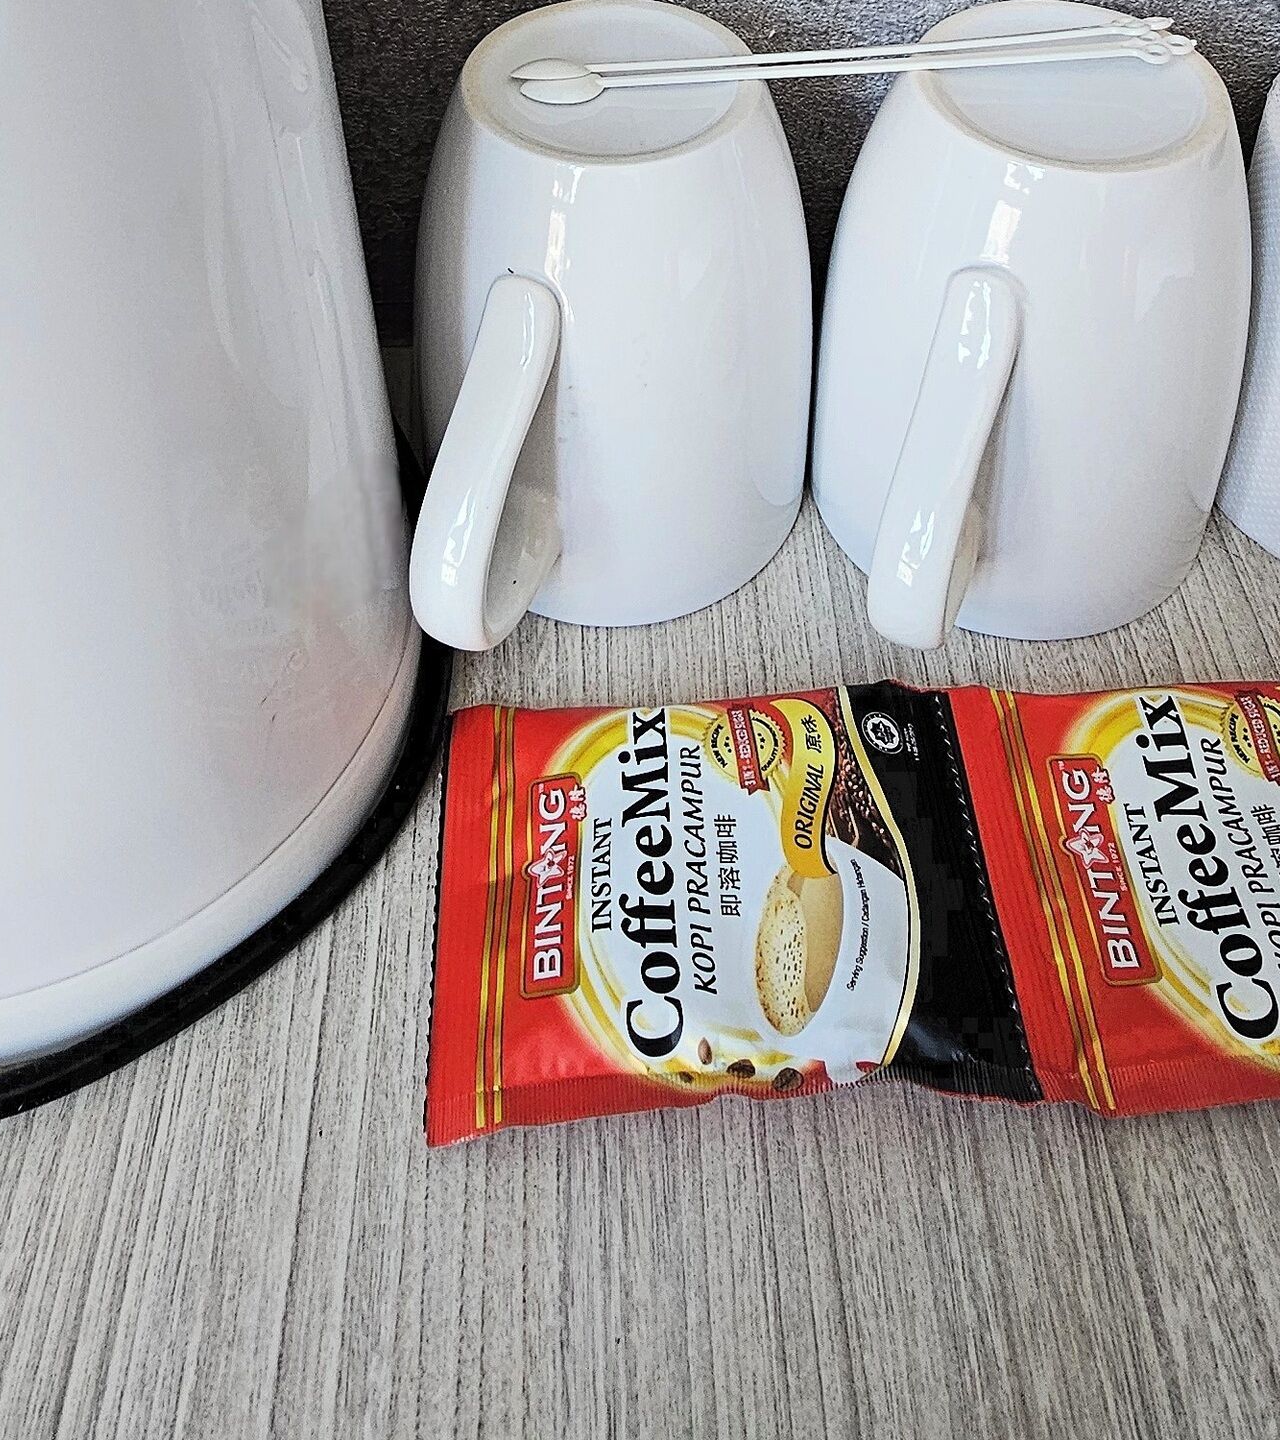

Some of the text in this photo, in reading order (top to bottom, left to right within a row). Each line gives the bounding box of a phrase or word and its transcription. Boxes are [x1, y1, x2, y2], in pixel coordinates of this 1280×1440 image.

[710, 724, 728, 768] NEW RECIPE
[800, 714, 823, 754] 原味
[1228, 712, 1250, 764] NEW RECIPE
[794, 764, 824, 849] ORIGINAL
[1200, 737, 1275, 894] PRACAMPUR
[526, 788, 568, 982] BINTANG
[591, 818, 612, 933] INSTANT
[618, 708, 684, 1058] CoffeeMix
[679, 745, 717, 996] KOPI PRACAMPUR
[714, 814, 742, 917] 即溶咖啡
[1062, 769, 1140, 969] BINTANG
[1108, 842, 1128, 892] SINCE 1972
[1123, 803, 1180, 927] INSTANT
[1135, 695, 1279, 1039] CoffeeMix
[846, 964, 863, 991] Serving
[856, 928, 869, 965] Suggestion
